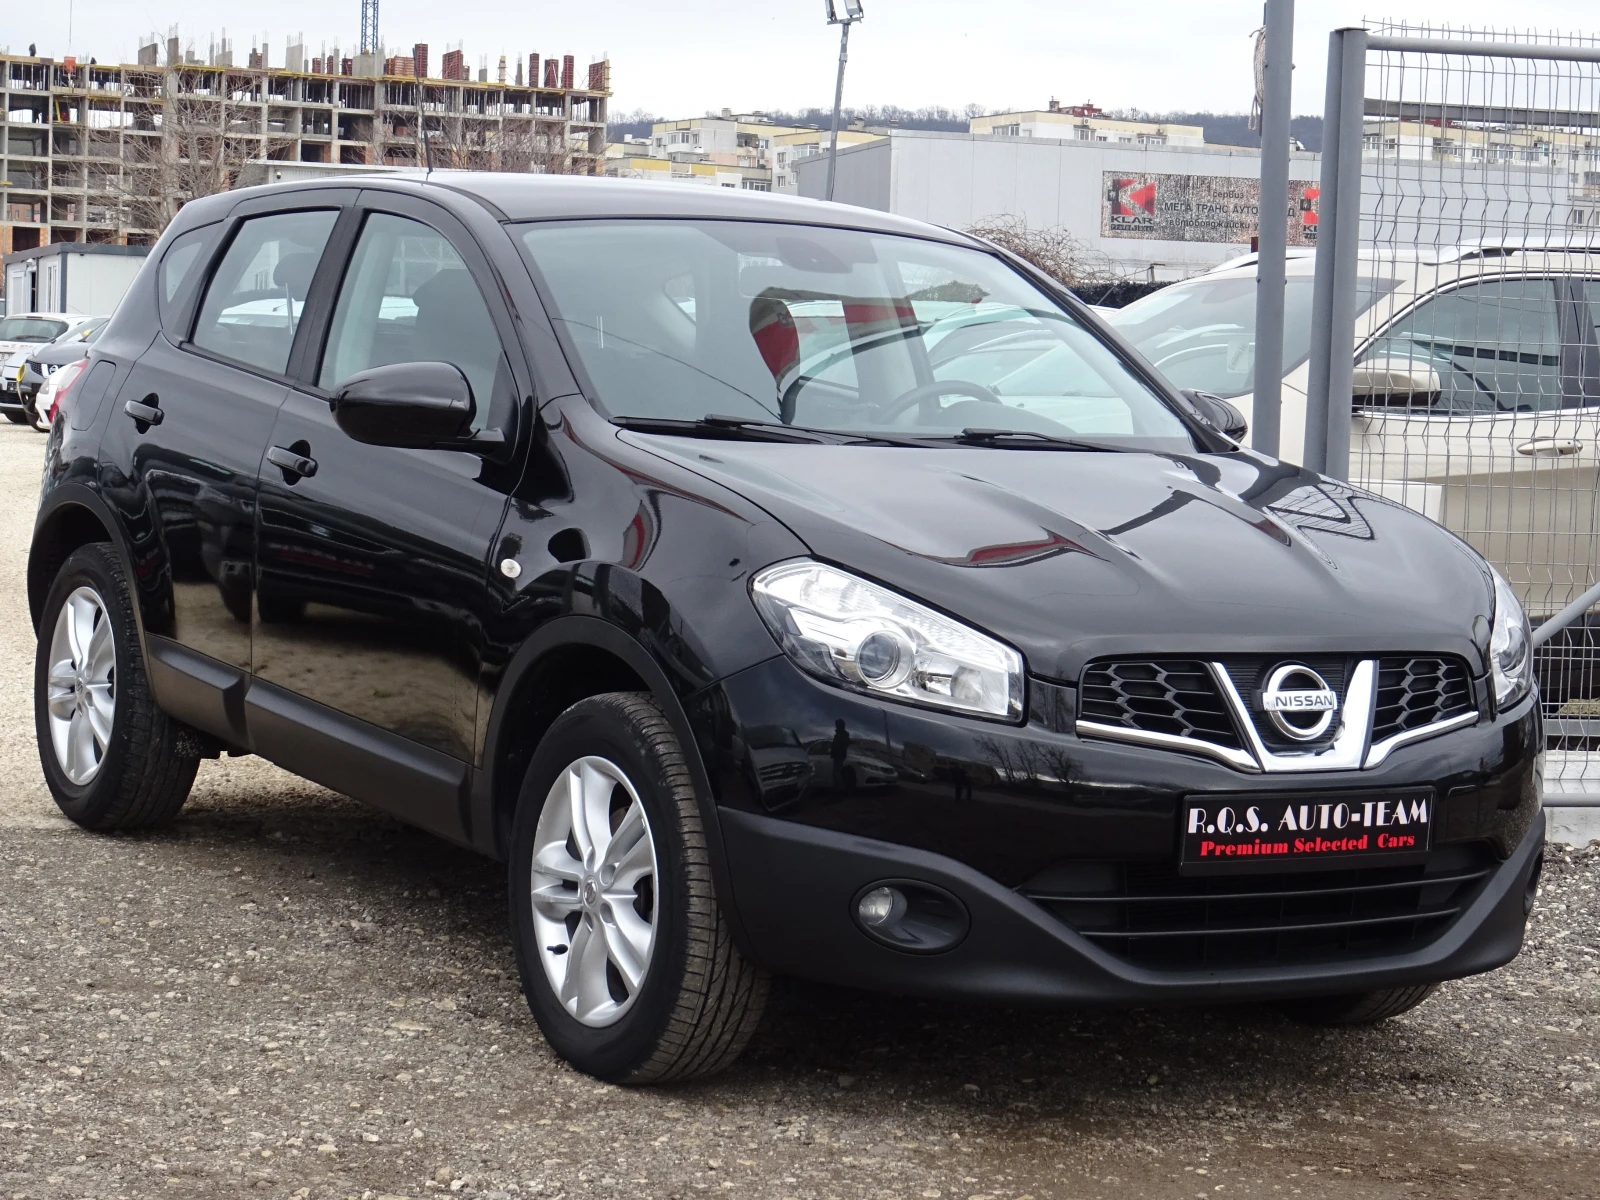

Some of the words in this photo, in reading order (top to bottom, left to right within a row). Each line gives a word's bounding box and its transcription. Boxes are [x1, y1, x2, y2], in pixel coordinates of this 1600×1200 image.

[1213, 190, 1244, 199] сервиз
[1164, 202, 1192, 212] МЕГА
[1196, 204, 1228, 214] ТРАНС
[1233, 205, 1259, 215] АУТО
[1111, 216, 1153, 225] KLAR
[1275, 695, 1333, 707] NISSAN
[1277, 798, 1429, 832] AUTO-TEAM
[1200, 839, 1289, 857] Premium
[1293, 834, 1369, 853] Selected
[1377, 832, 1416, 849] Cars
